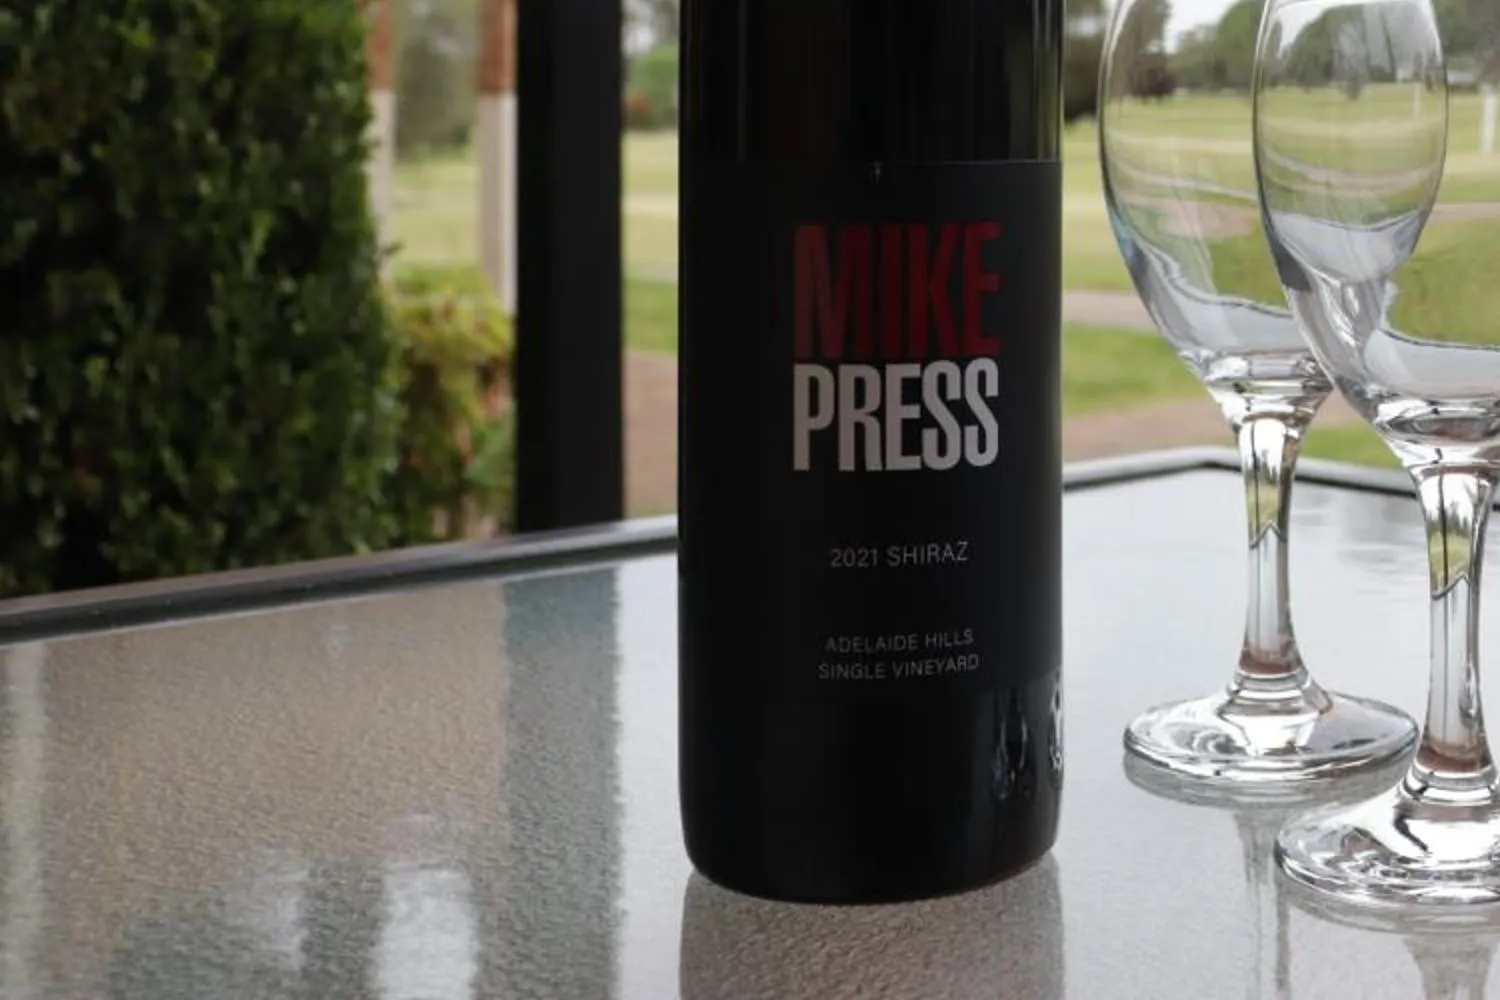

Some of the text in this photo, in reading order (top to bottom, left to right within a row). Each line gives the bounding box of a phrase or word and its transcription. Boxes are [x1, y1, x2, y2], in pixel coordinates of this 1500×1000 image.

[793, 222, 1002, 359] MIKE
[793, 358, 1000, 472] PRESS
[830, 541, 969, 569] 2021 SHIRAZ
[825, 628, 974, 654] ADELAIDE HILLS
[818, 653, 980, 681] SINGLE VINEYARD
